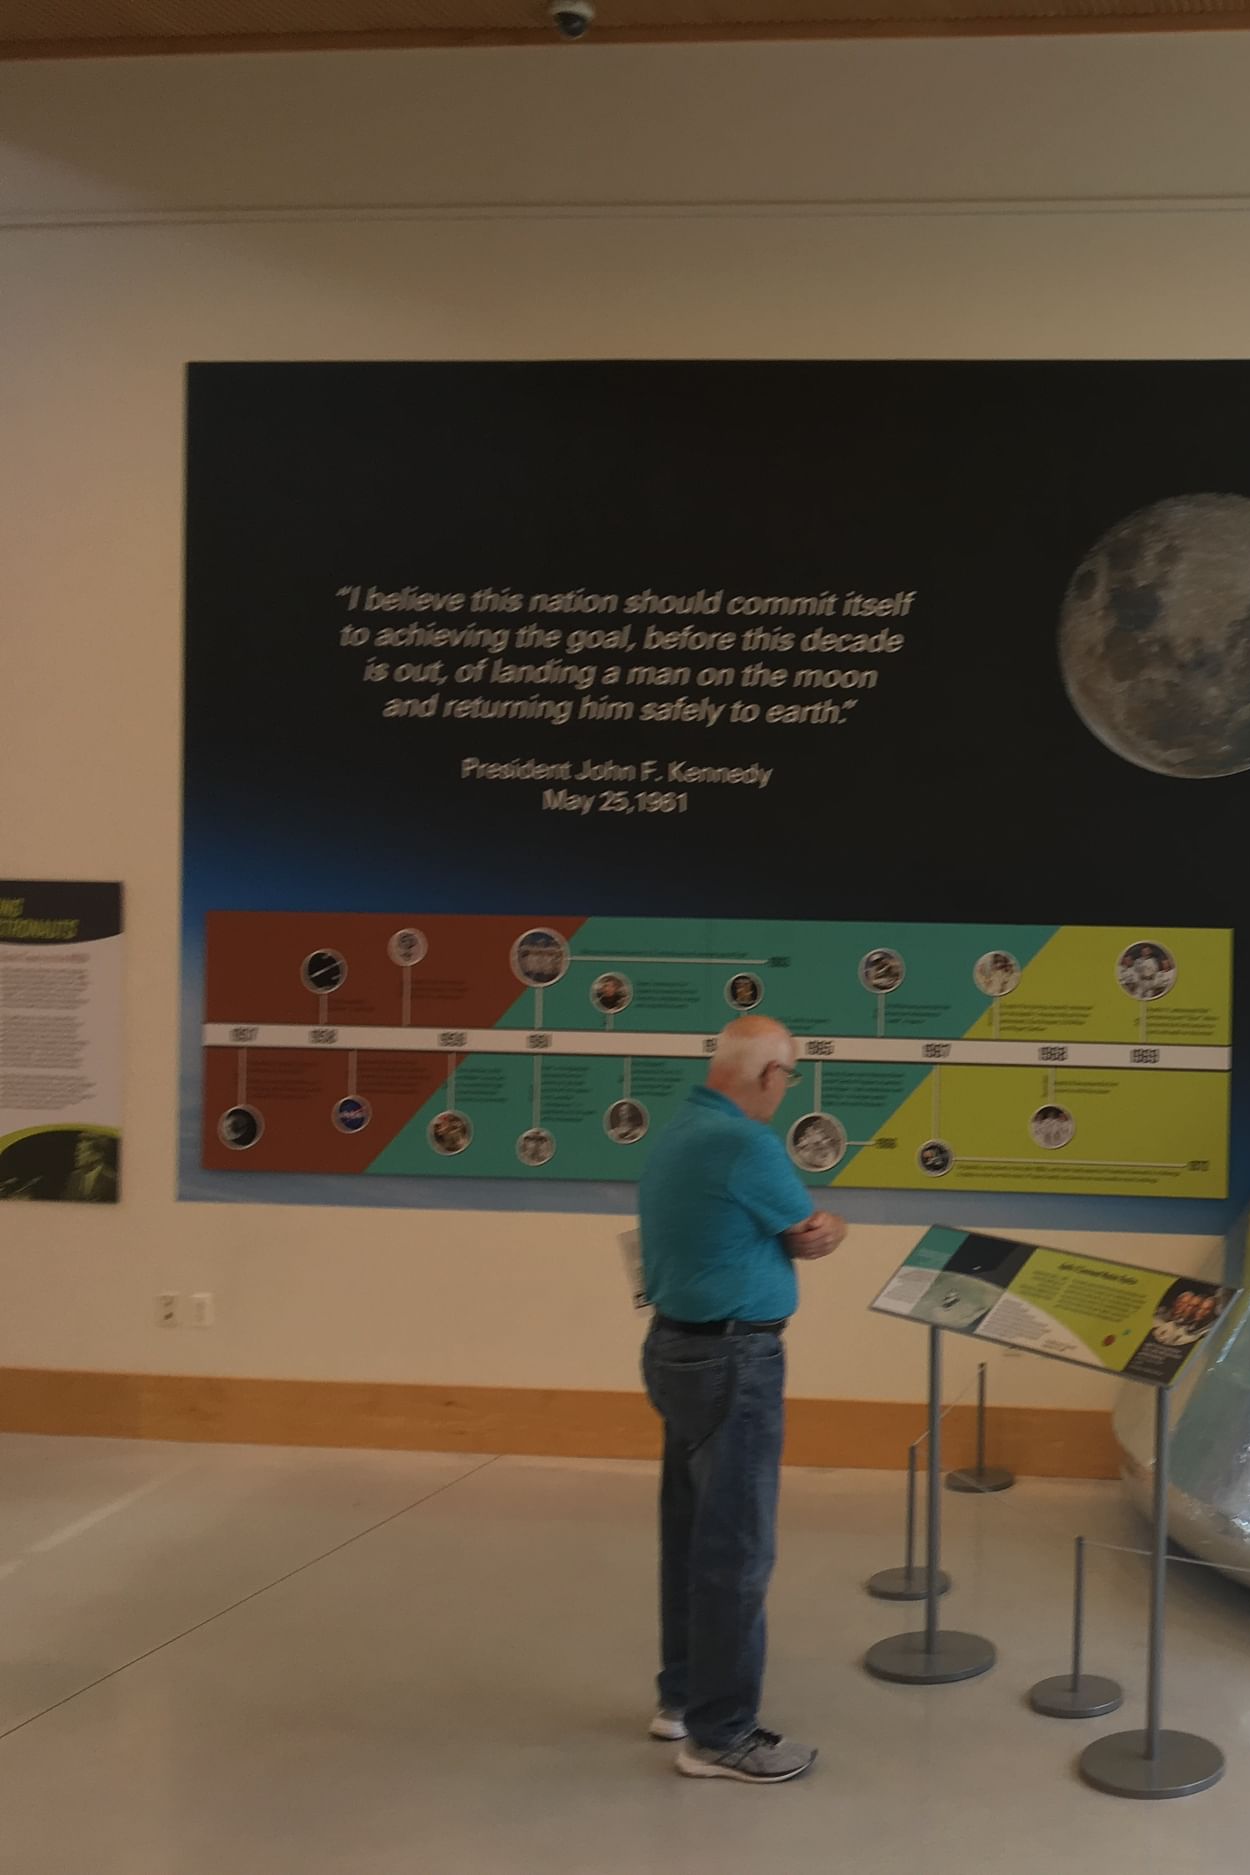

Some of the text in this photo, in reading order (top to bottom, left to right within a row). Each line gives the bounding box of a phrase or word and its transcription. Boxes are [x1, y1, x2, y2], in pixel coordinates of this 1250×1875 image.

[363, 586, 465, 612] believe
[469, 586, 524, 612] this
[528, 587, 619, 613] nation
[623, 589, 724, 614] should
[727, 591, 838, 616] commit
[842, 591, 917, 616] itself
[339, 622, 904, 654] to achieving the goal, before this decade
[363, 657, 878, 689] is out, of landing a man on the moon
[383, 693, 440, 718] and
[442, 694, 573, 725] returning
[578, 695, 634, 721] him
[639, 696, 726, 728] safely
[730, 700, 760, 723] to
[461, 757, 774, 788] President John F. Kennedy
[542, 789, 596, 815] May
